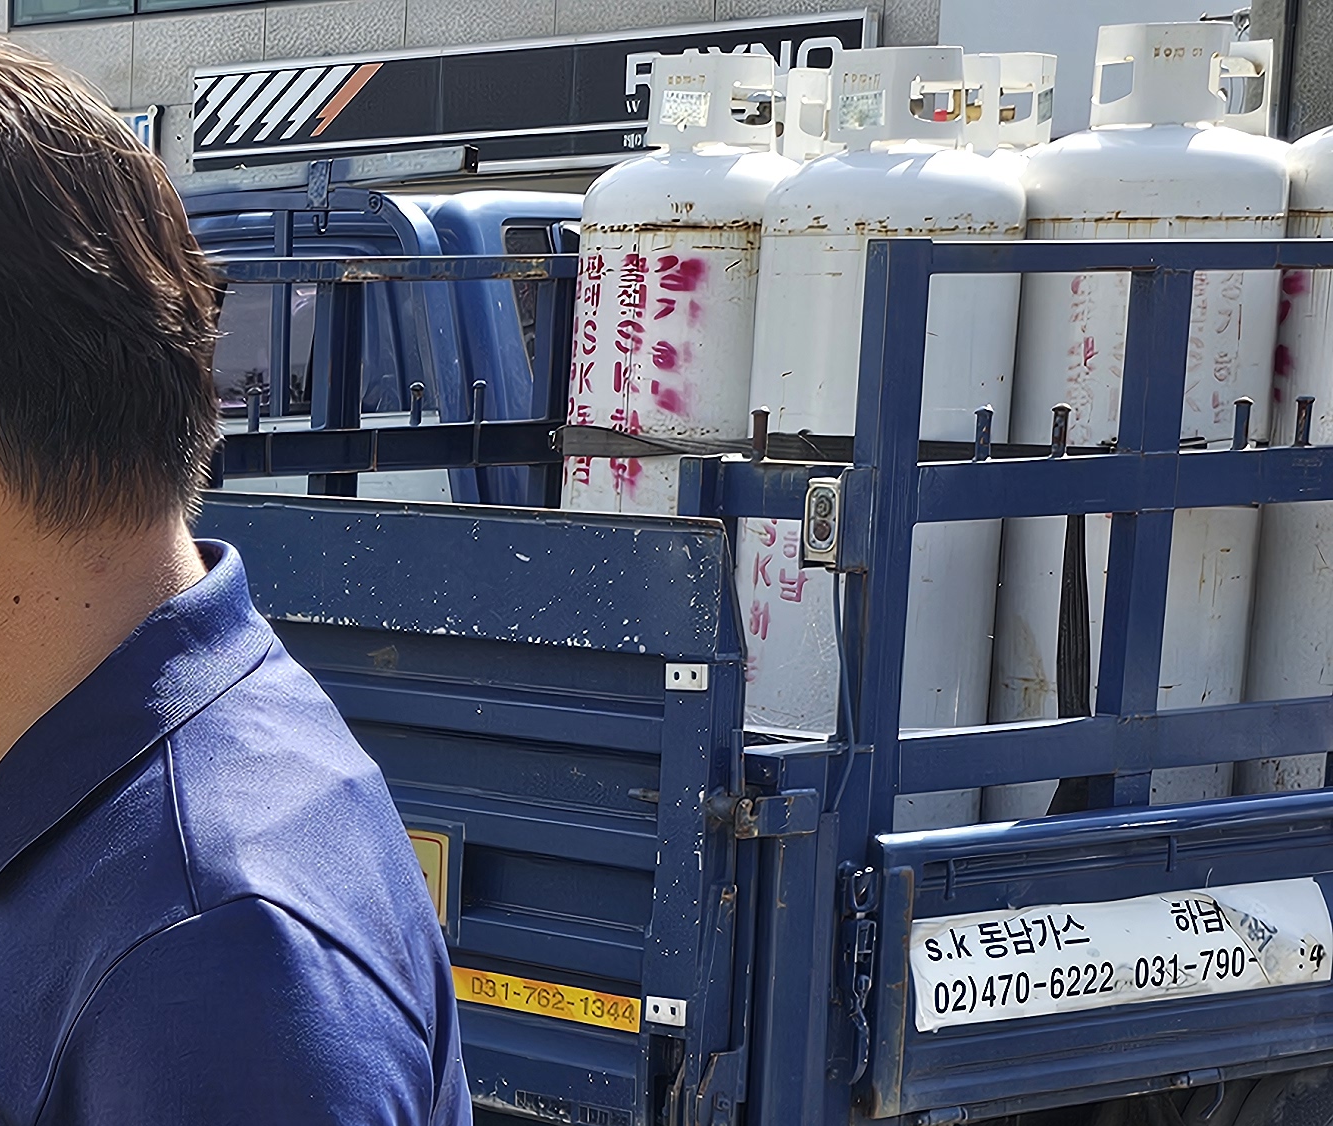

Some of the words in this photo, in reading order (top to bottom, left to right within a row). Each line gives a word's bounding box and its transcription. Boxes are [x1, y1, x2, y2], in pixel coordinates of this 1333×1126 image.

[924, 928, 972, 962] s.k
[977, 914, 1091, 959] 동남가스
[471, 976, 636, 1024] 031-762-1344
[934, 961, 1115, 1014] 02)470-6222
